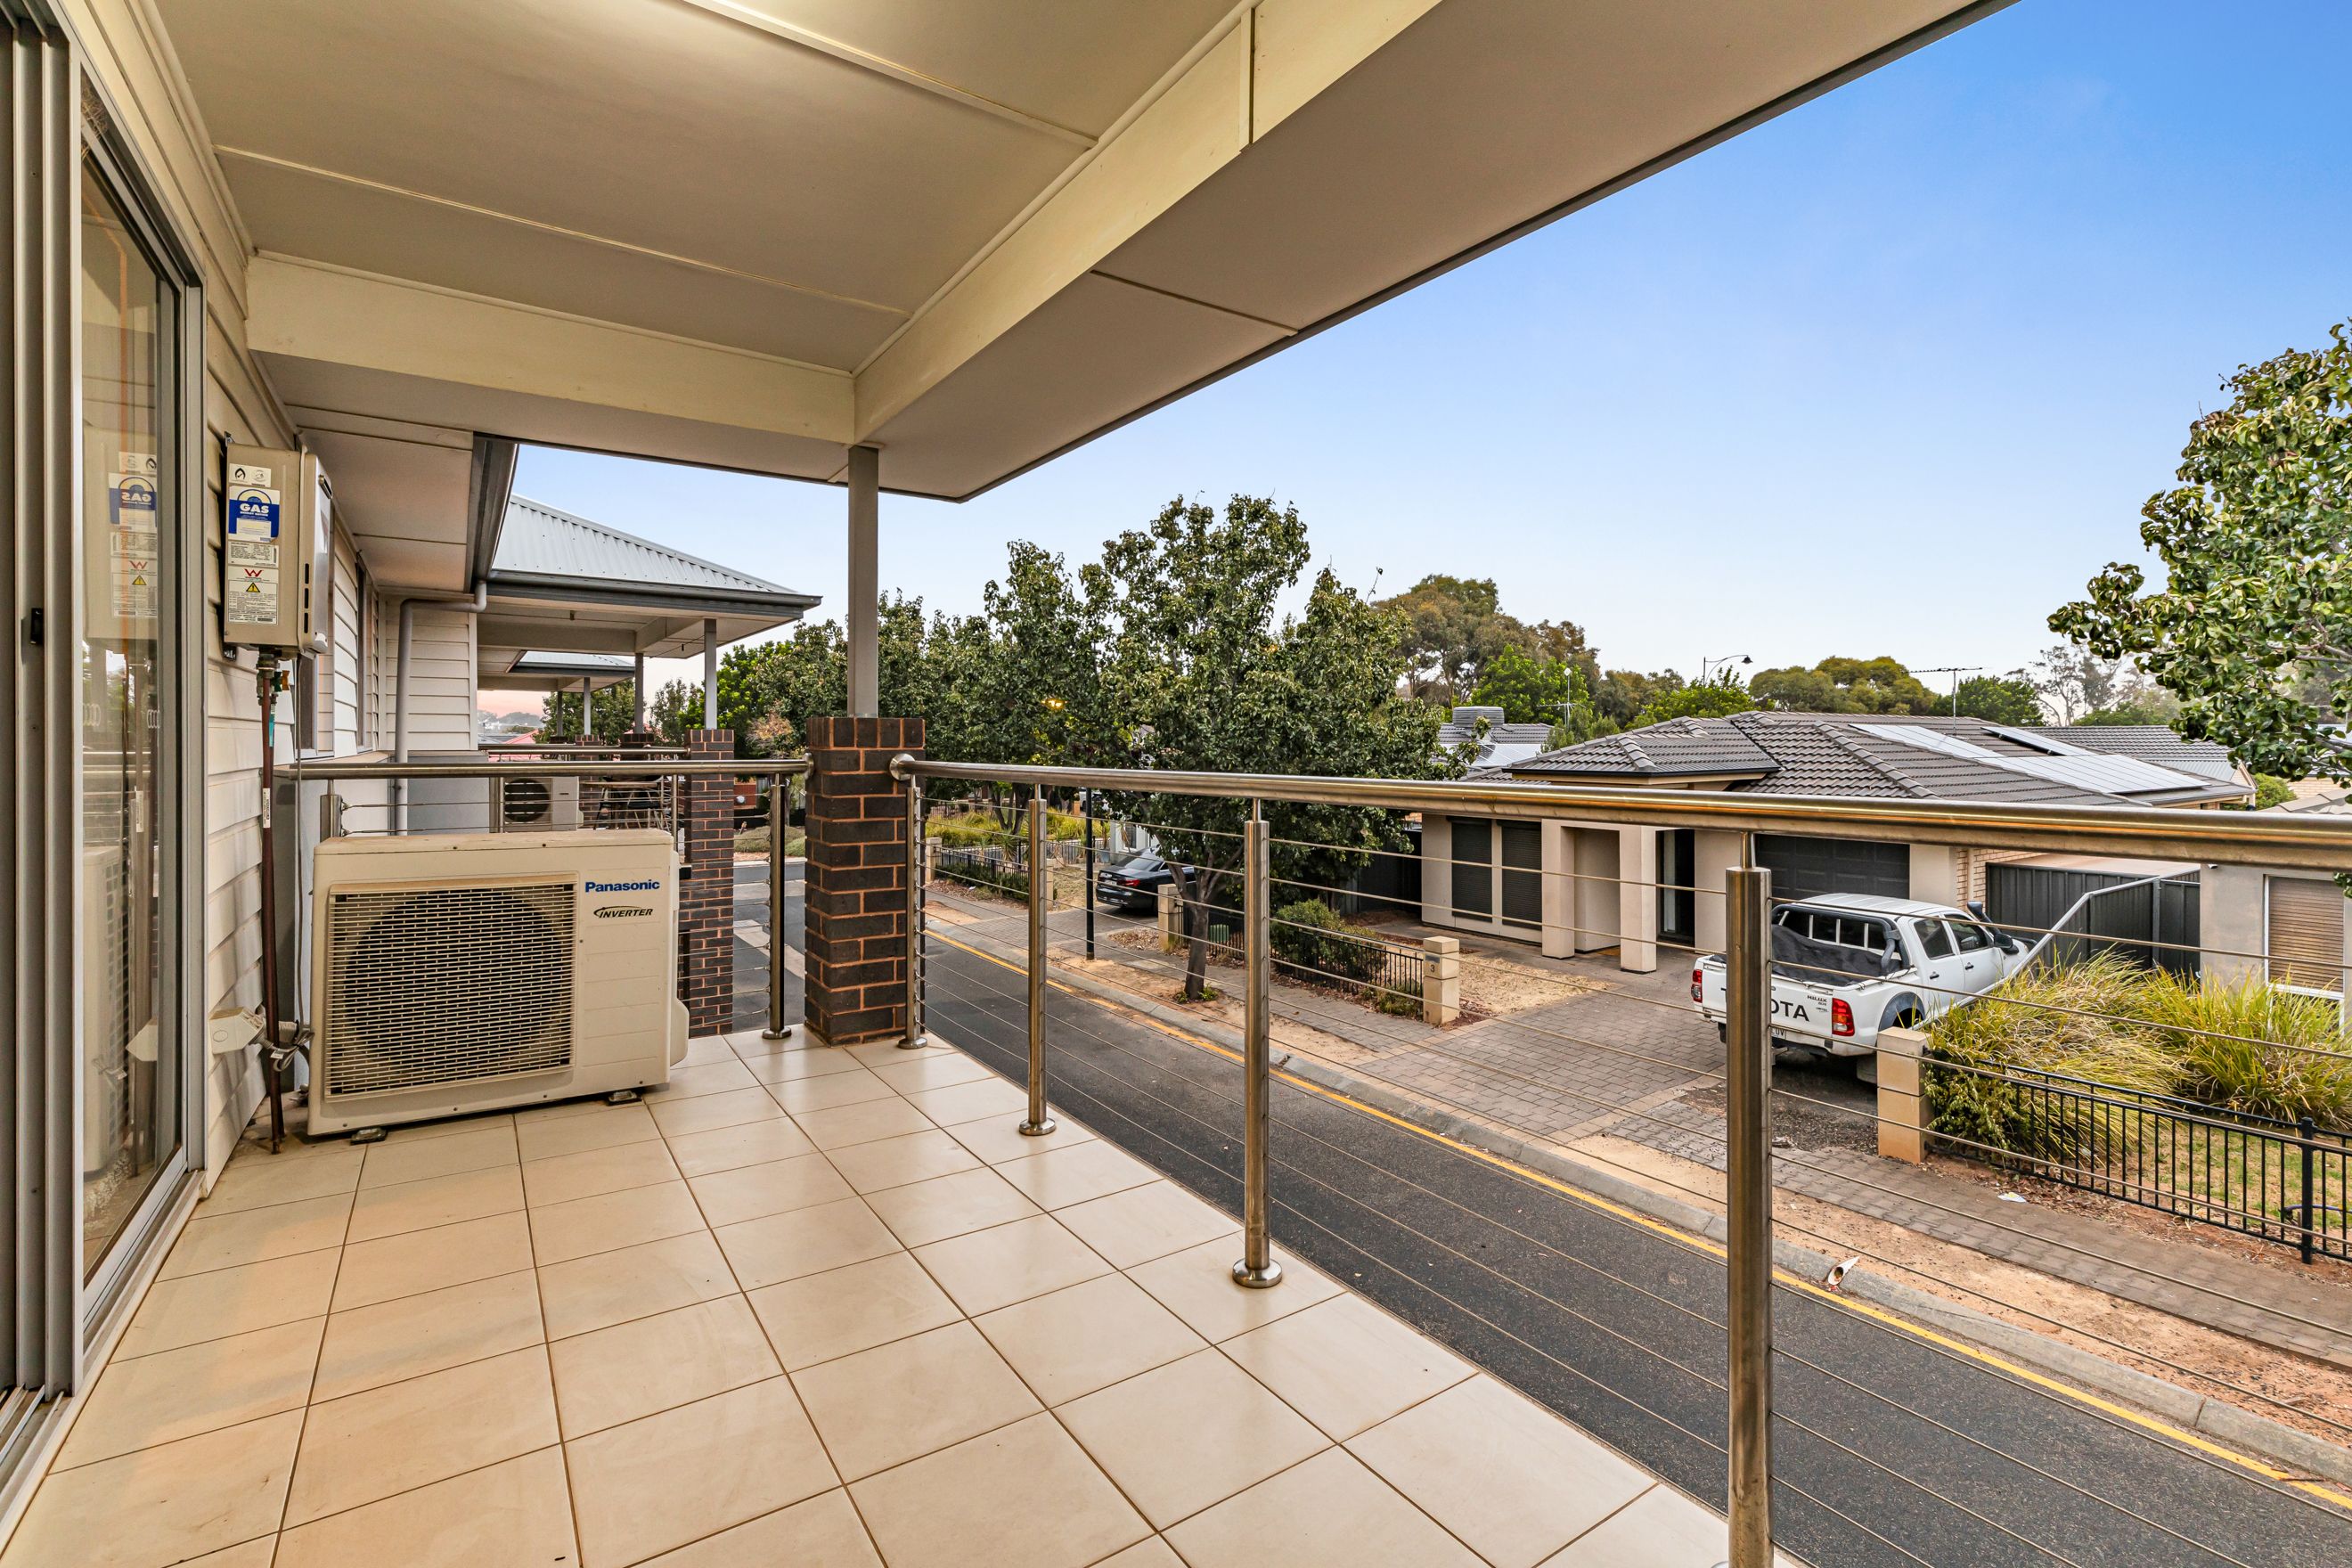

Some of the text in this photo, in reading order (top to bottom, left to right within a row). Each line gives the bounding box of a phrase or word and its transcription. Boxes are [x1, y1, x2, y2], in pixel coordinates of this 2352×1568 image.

[240, 502, 269, 514] GAS
[584, 879, 660, 893] Panasonic
[598, 908, 654, 919] INVERTER
[1430, 964, 1435, 973] 3
